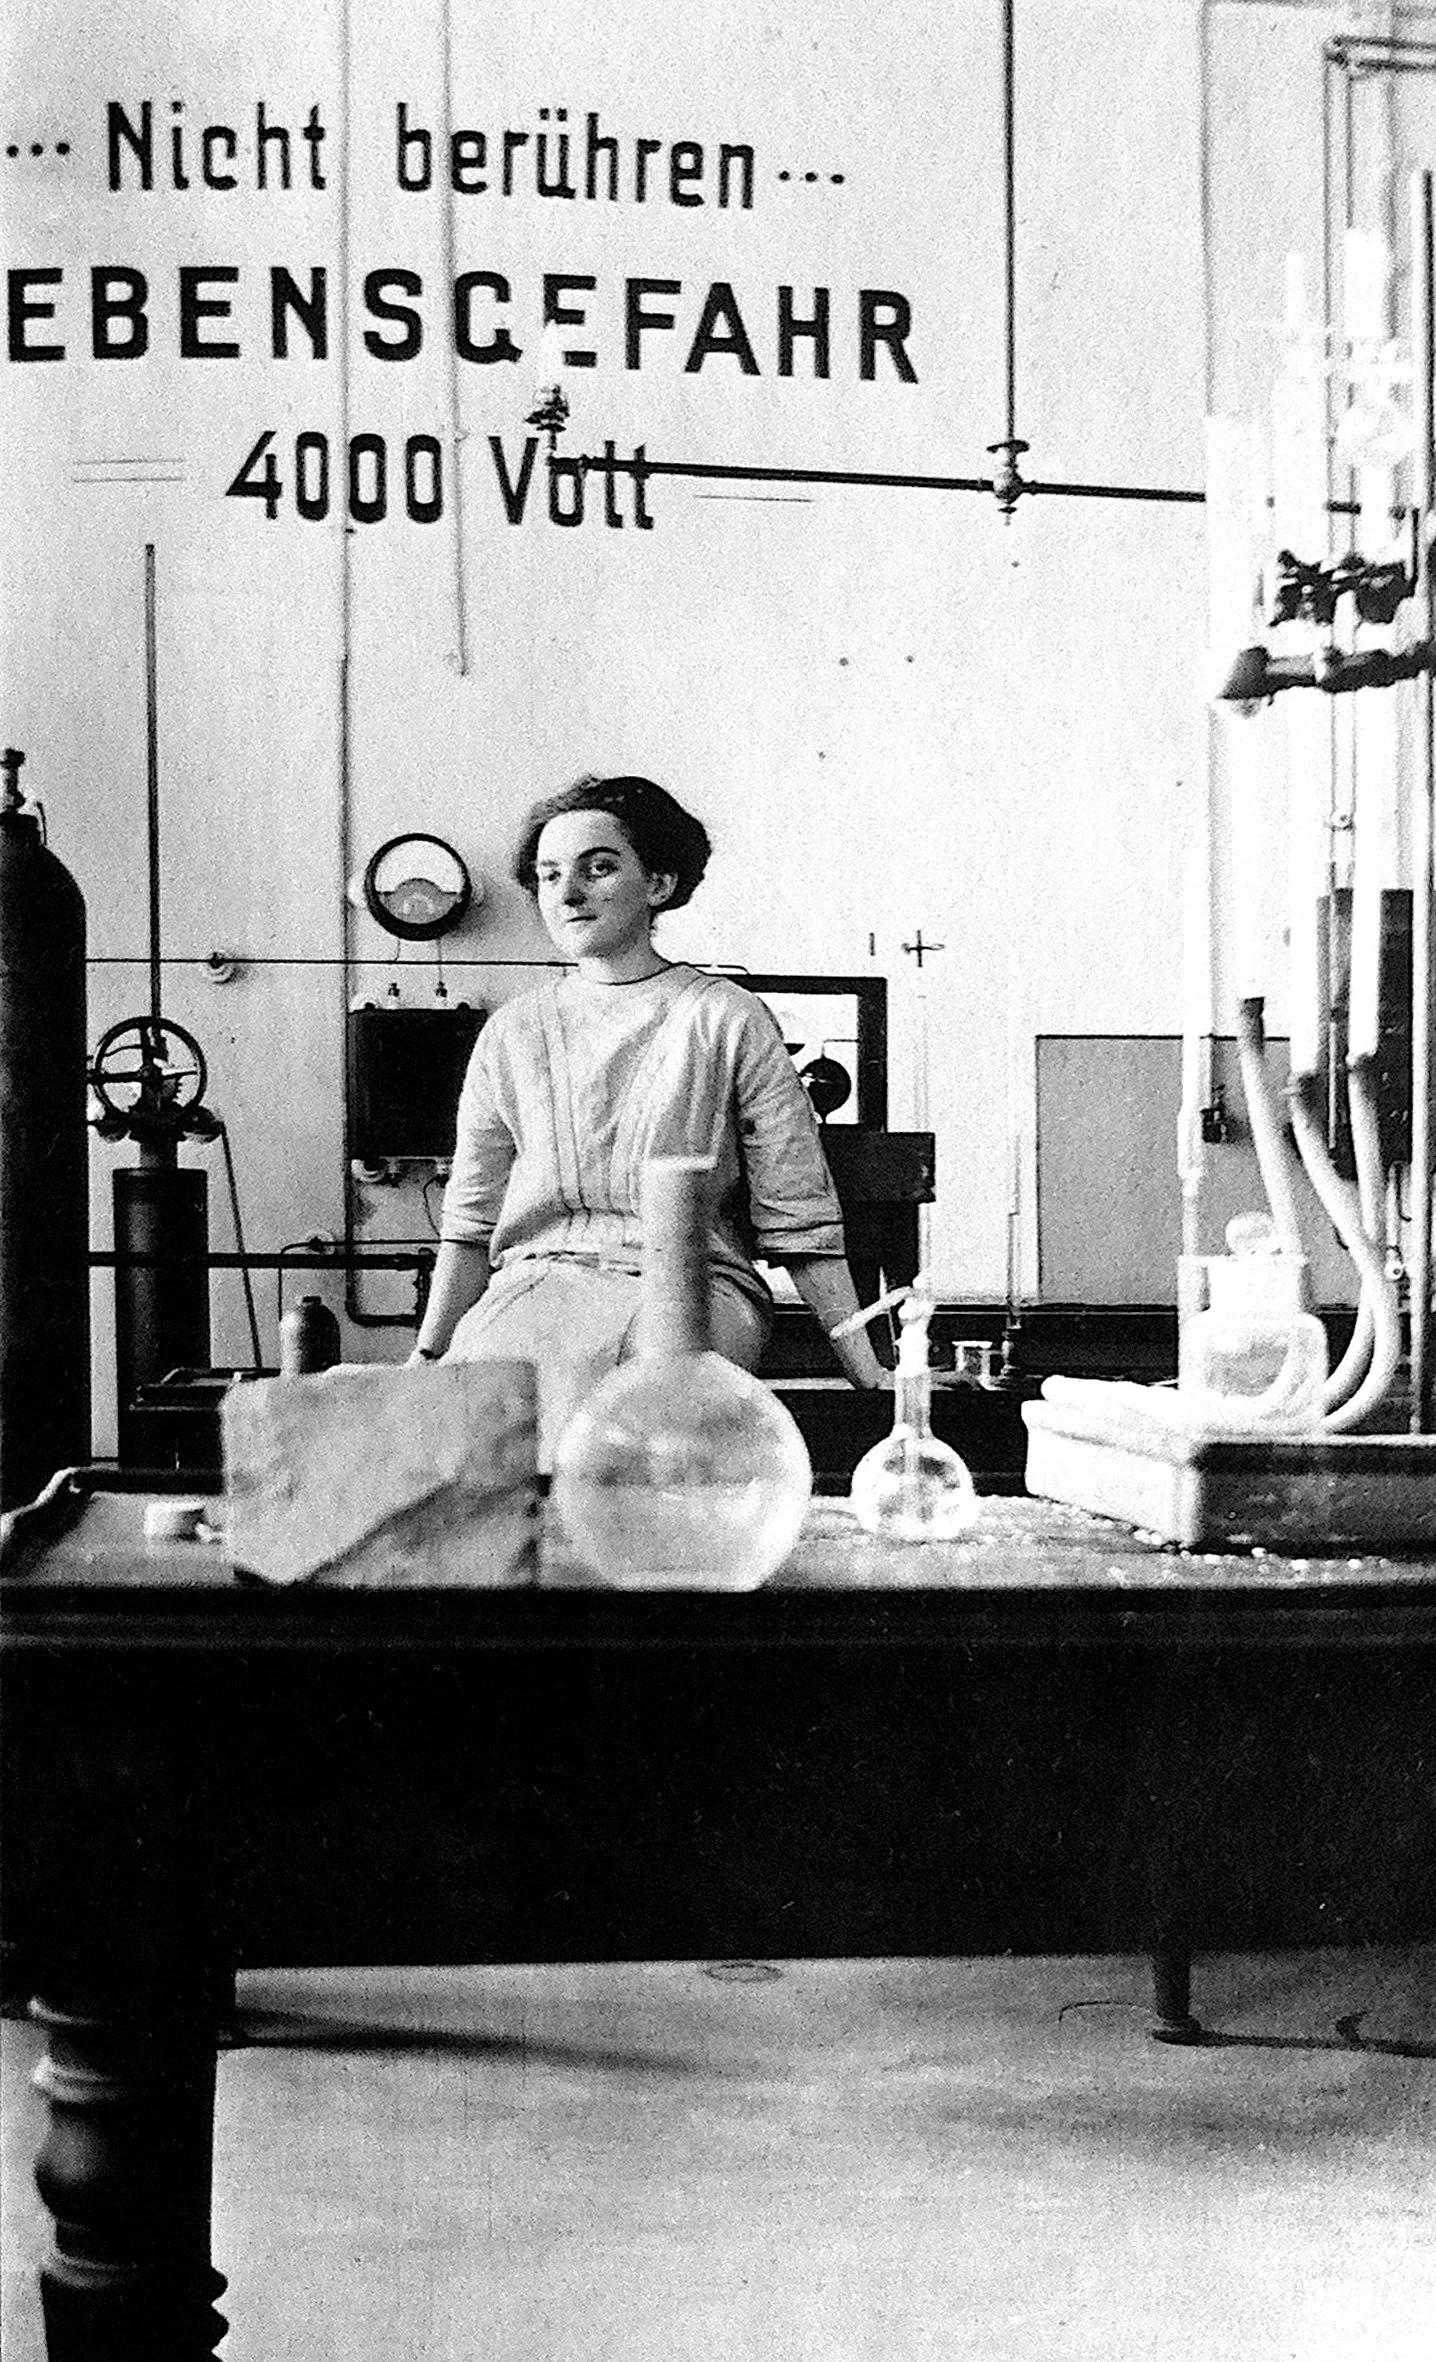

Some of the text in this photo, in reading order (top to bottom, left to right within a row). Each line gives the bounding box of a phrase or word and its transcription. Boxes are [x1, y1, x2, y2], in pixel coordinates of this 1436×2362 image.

[106, 100, 756, 210] Nicht berühren
[225, 430, 654, 530] 4000 Volt
